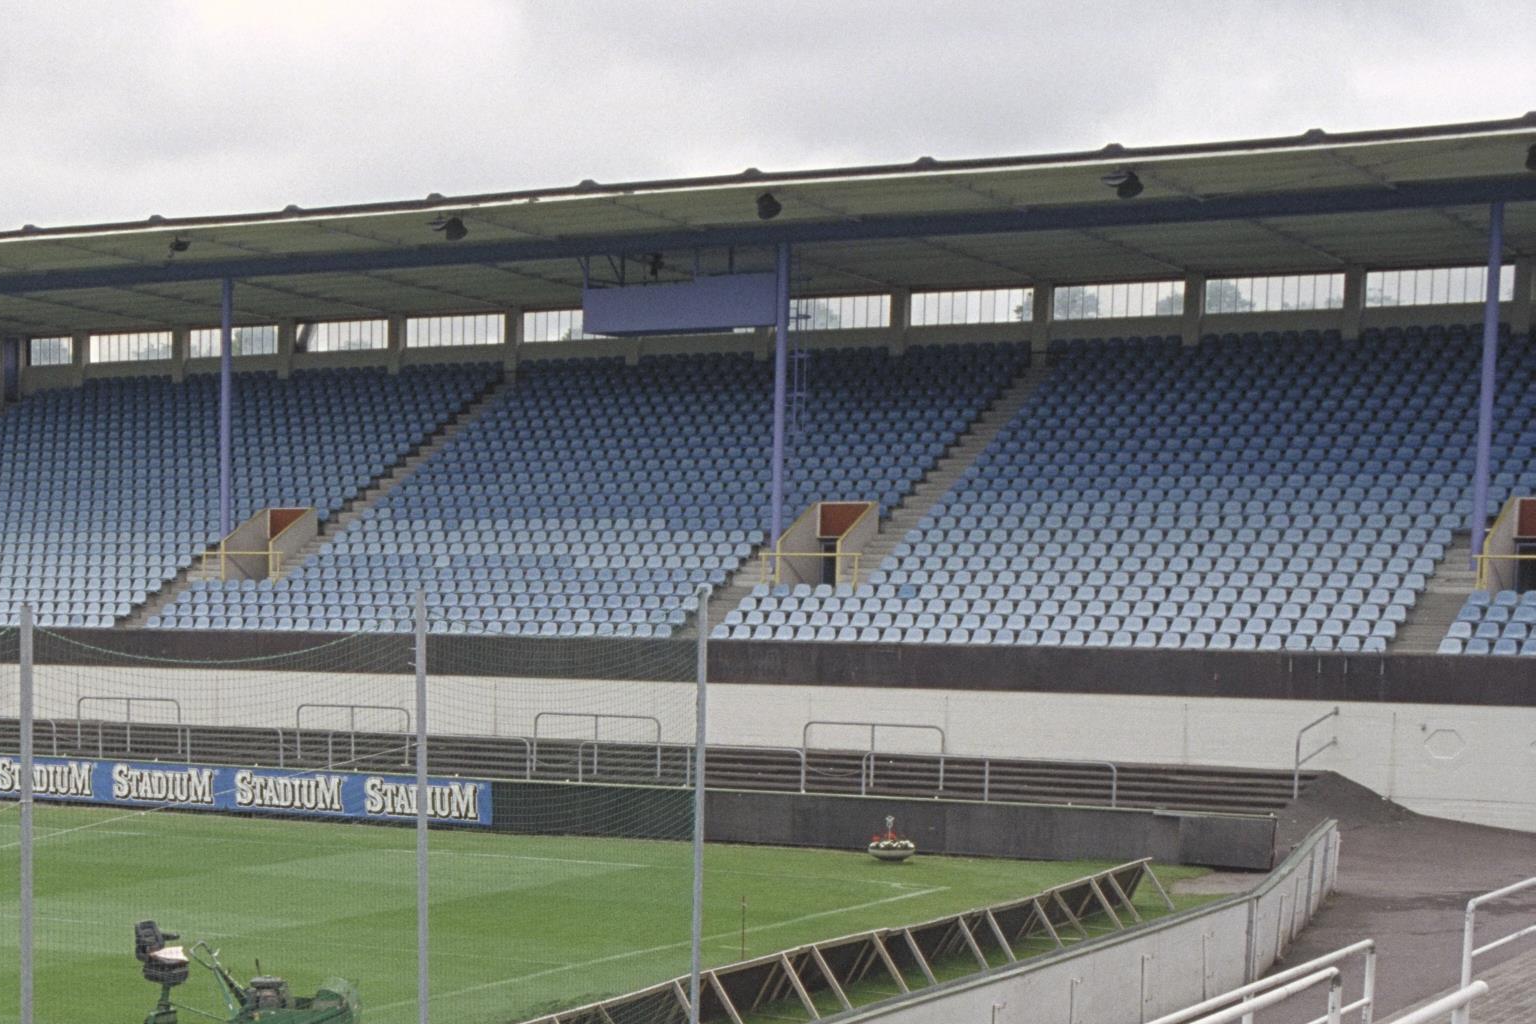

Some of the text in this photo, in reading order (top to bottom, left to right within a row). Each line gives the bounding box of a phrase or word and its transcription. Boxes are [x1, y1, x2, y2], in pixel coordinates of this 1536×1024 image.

[113, 764, 214, 805] STADIUM
[235, 768, 344, 813] STADIUM
[366, 777, 479, 821] STAIUM
